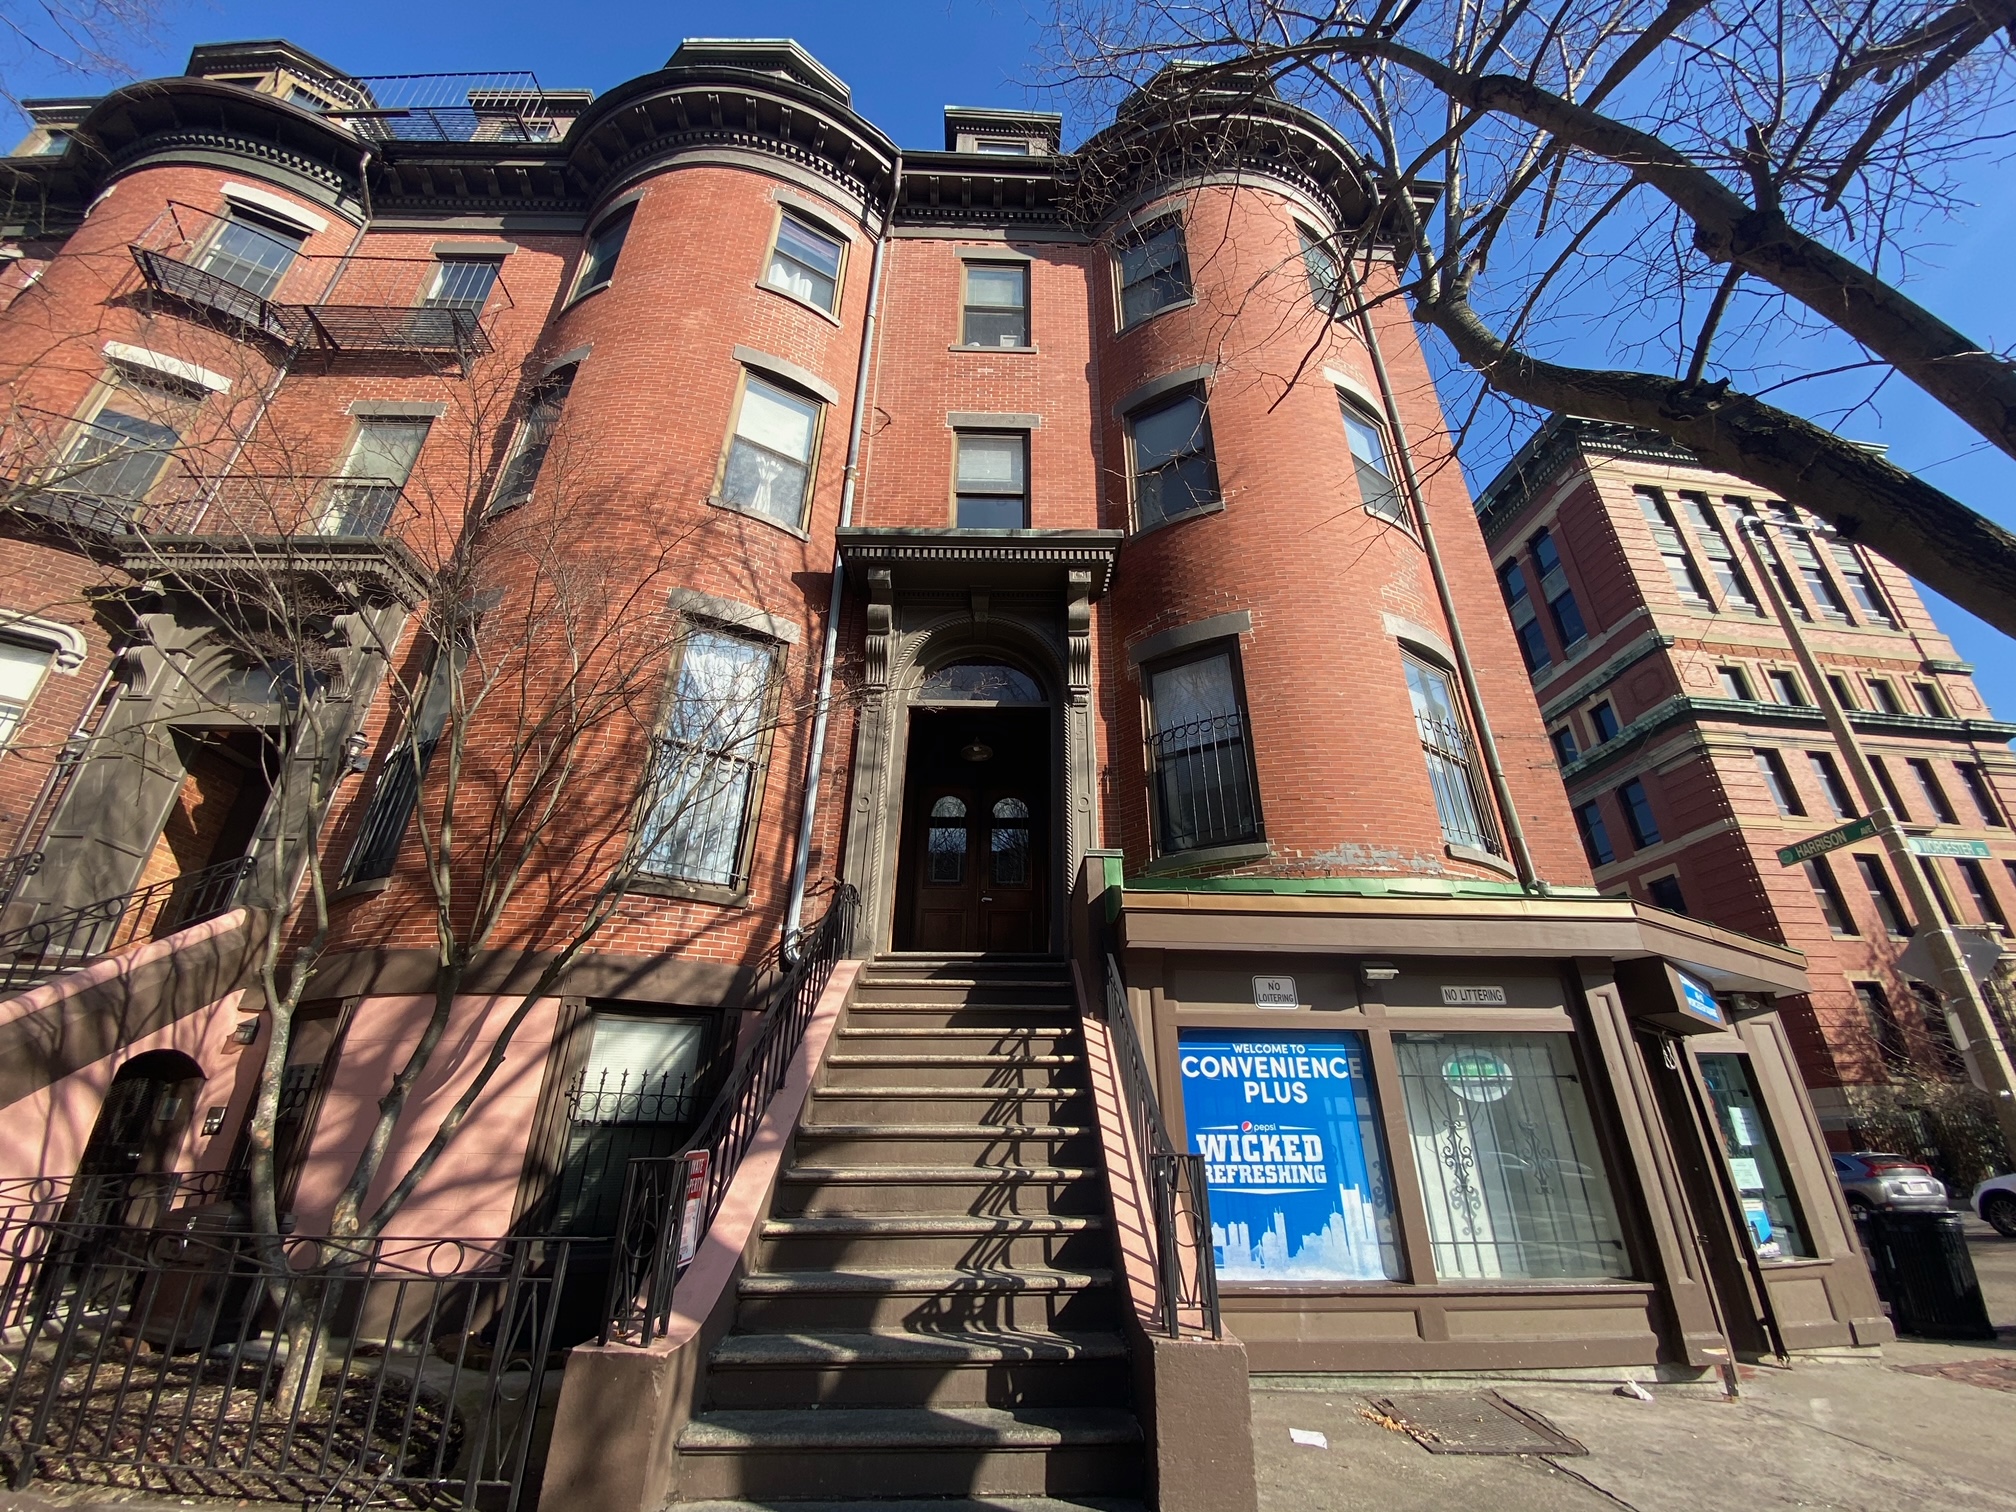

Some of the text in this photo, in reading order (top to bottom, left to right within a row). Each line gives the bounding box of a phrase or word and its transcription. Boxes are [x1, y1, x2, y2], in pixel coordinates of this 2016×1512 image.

[1795, 825, 1874, 858] HARRISON AVE
[1917, 840, 1975, 855] WORCESTER
[1268, 982, 1281, 991] NO
[1258, 993, 1294, 1002] LOITERING
[1444, 989, 1503, 1001] NO LITTERING
[1232, 1043, 1306, 1054] WELCOME TO
[1181, 1056, 1364, 1079] CONVENIENCE
[1243, 1081, 1308, 1104] PLUS
[1254, 1122, 1276, 1133] pepsi
[1196, 1134, 1324, 1162] WICKED
[1204, 1164, 1328, 1184] REFRESHING
